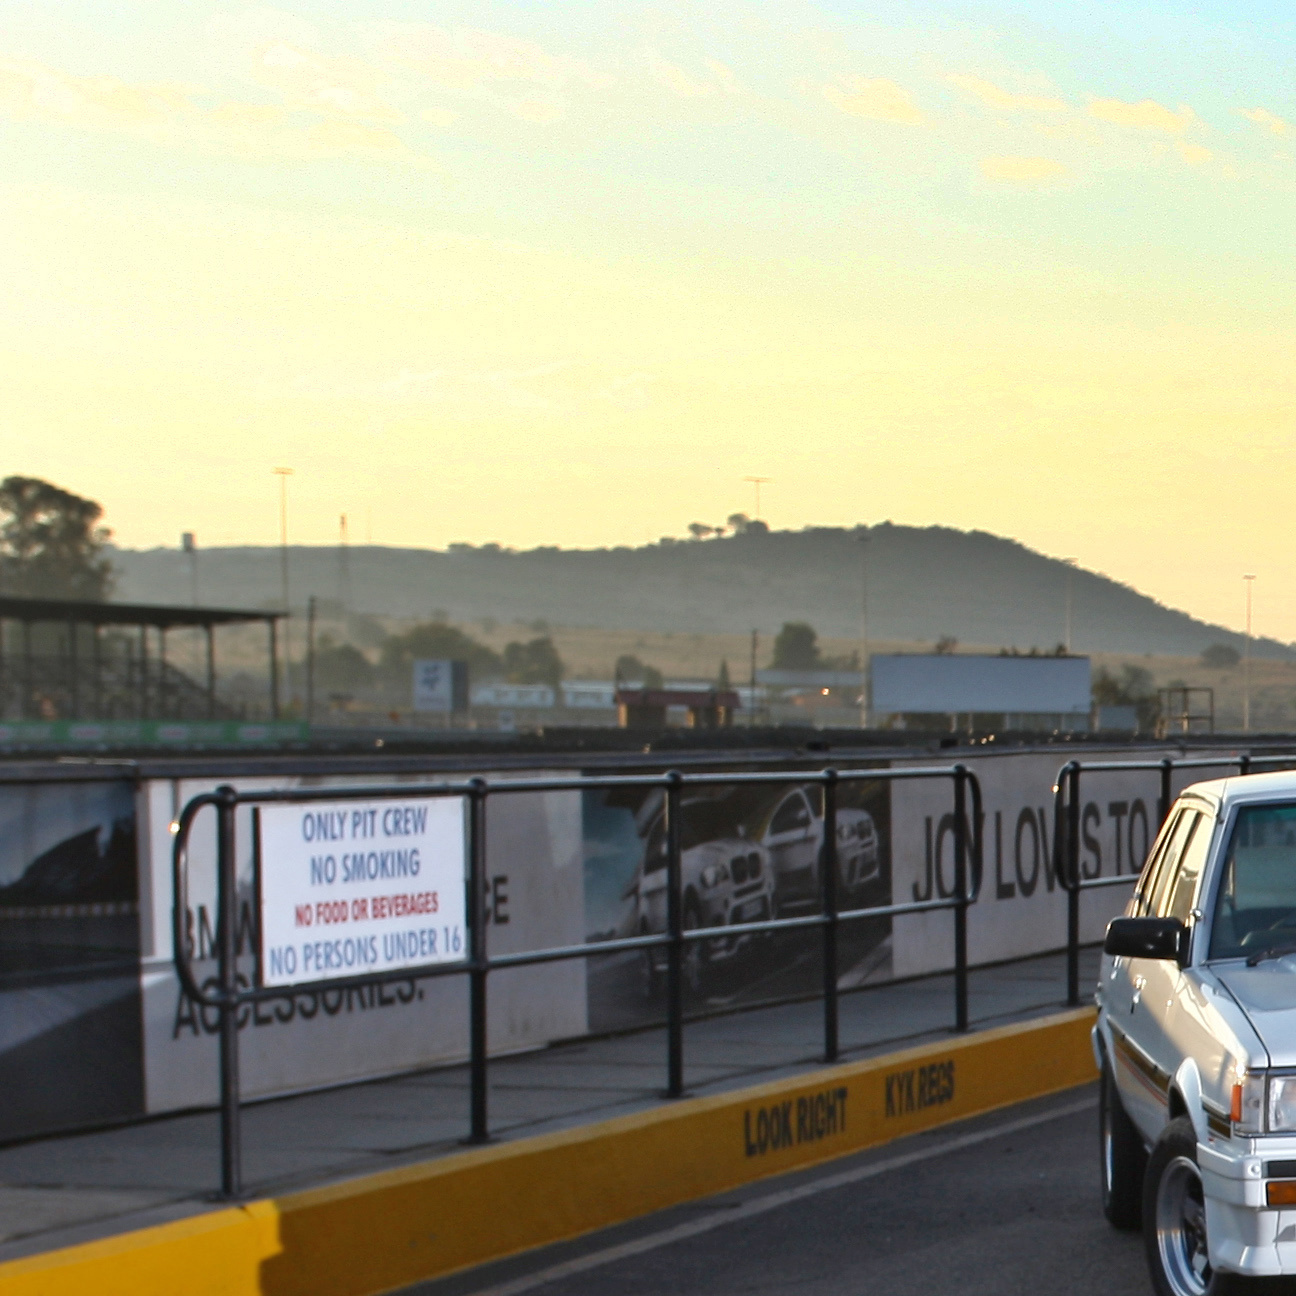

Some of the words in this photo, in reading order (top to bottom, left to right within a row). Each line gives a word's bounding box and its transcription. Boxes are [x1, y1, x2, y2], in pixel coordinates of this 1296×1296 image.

[302, 810, 347, 843] ONLY
[352, 808, 377, 839] PIT
[383, 806, 428, 837] CREW
[310, 854, 337, 886] NO
[342, 848, 420, 883] SMOKING
[295, 903, 313, 927] NO
[316, 901, 348, 924] FOOD
[353, 899, 370, 921] OR
[372, 891, 439, 919] BEVERAGES
[270, 945, 297, 978] NO
[303, 934, 377, 973] PERSONS
[383, 928, 438, 962] UNDER
[444, 926, 461, 954] 16
[744, 1101, 793, 1158] LOOK
[796, 1086, 848, 1144] RIGHT
[884, 1069, 915, 1119] KYK
